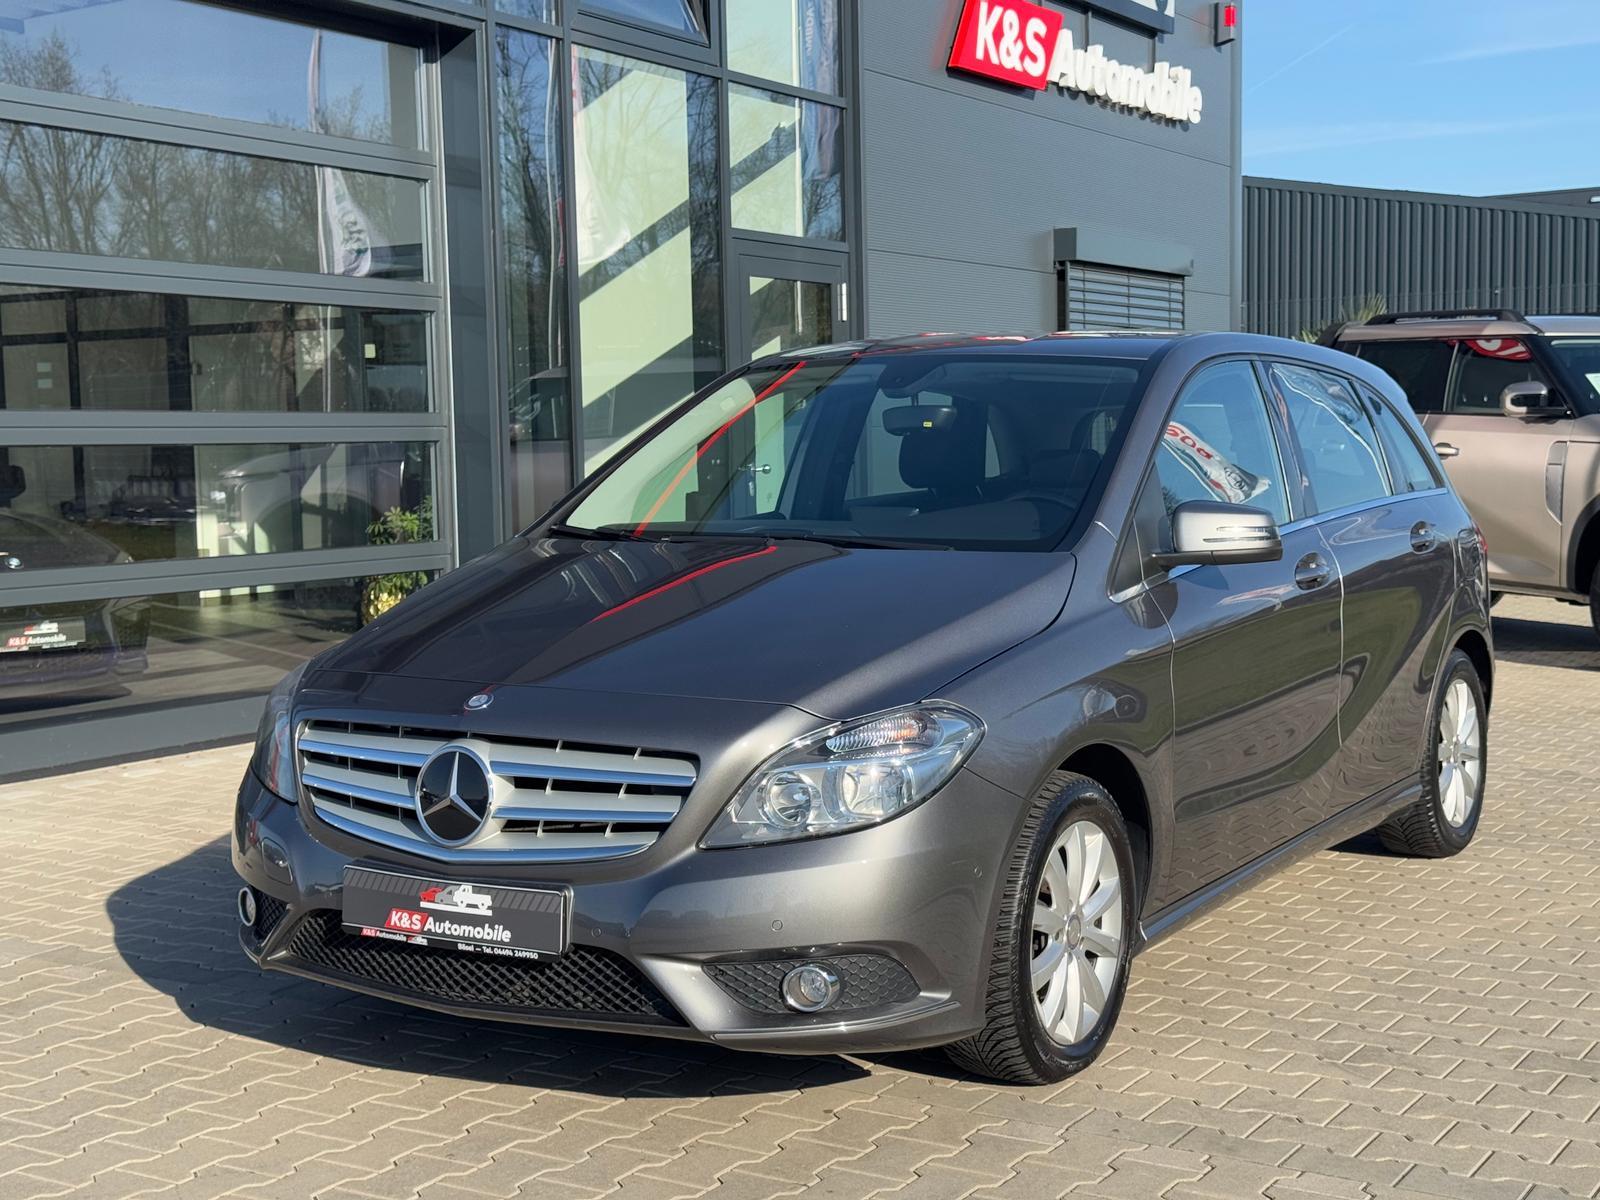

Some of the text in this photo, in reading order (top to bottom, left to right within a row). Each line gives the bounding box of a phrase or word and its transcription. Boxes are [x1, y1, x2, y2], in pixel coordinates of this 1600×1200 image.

[976, 1, 1203, 124] K&S Automobile
[390, 911, 512, 943] K&S Automobile
